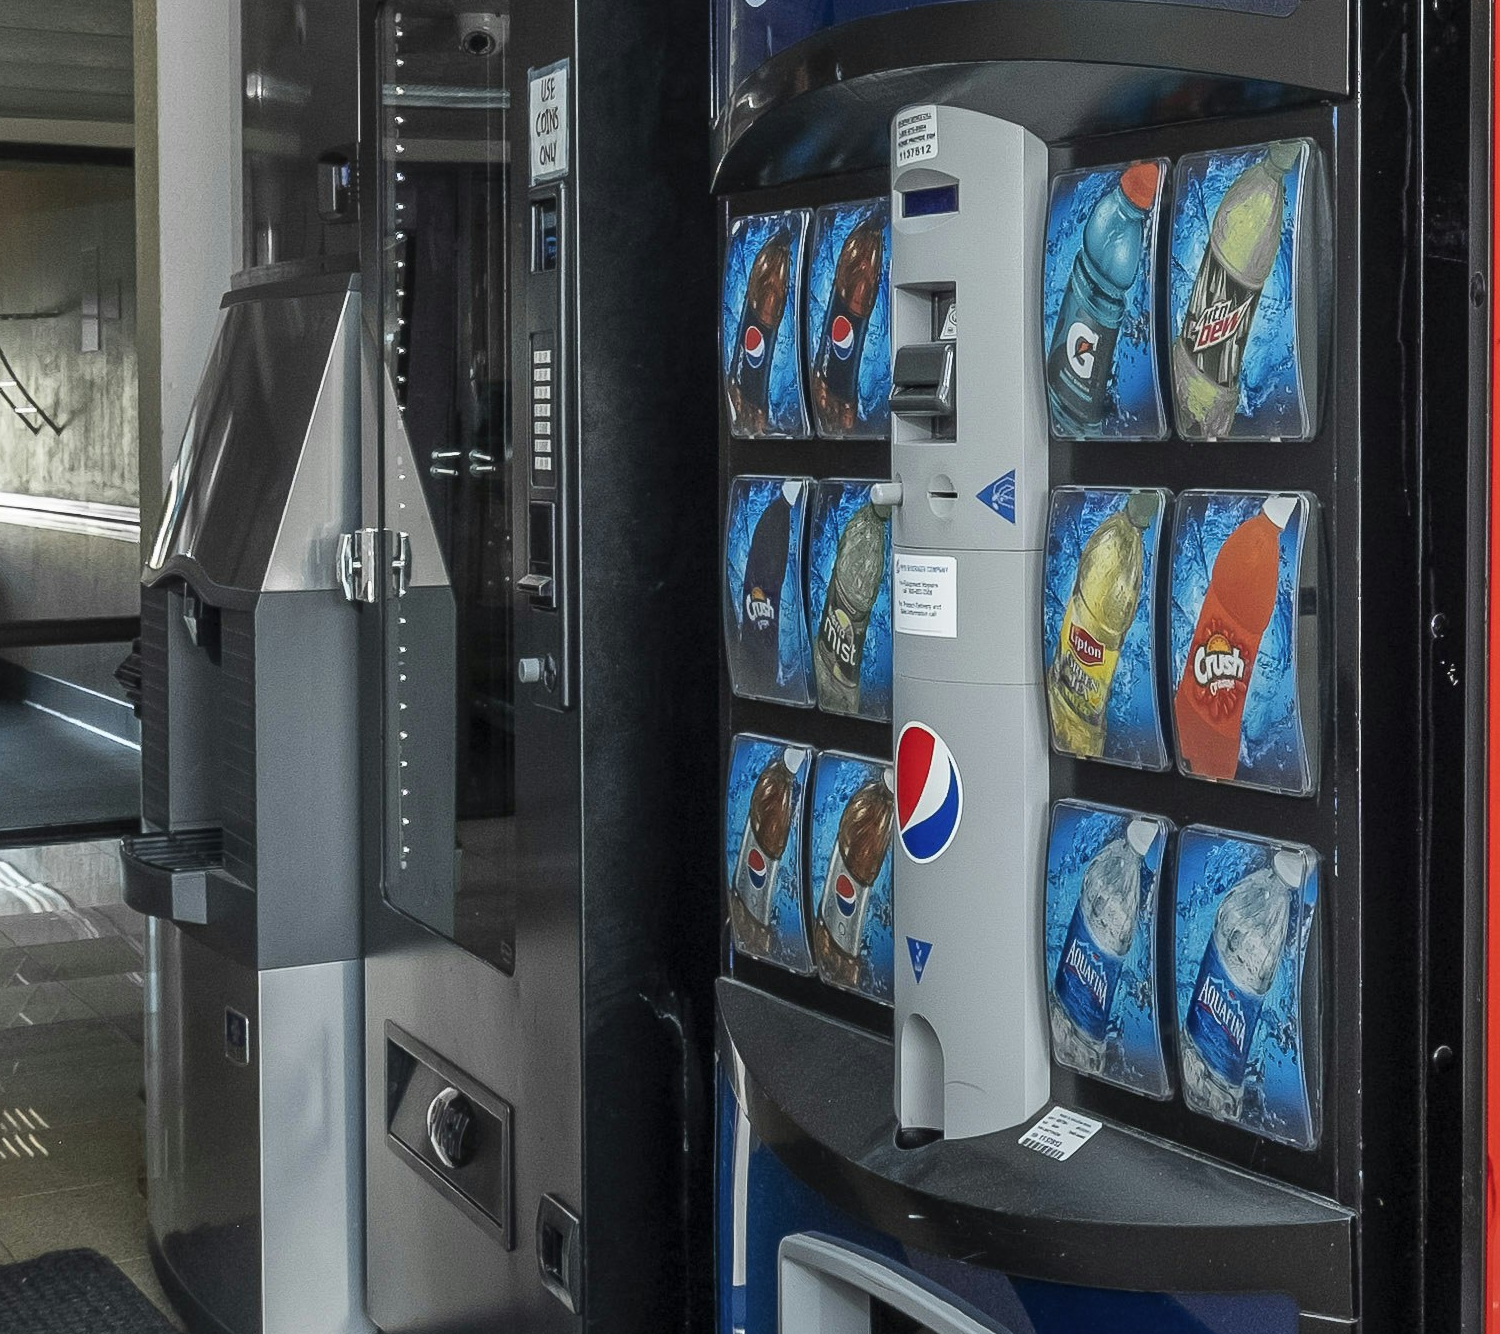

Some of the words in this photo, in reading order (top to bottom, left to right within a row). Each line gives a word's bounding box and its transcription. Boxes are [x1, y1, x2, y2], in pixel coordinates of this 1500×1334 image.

[540, 77, 556, 102] USE
[536, 106, 559, 137] COINS
[539, 140, 557, 167] ONLY
[1066, 322, 1100, 379] G
[746, 593, 775, 622] Crush
[824, 616, 856, 666] mist
[1070, 623, 1101, 659] Lipton
[1194, 646, 1245, 685] Crush
[1065, 939, 1108, 1012] AQUAFINA
[1197, 978, 1247, 1054] AQUAFINA
